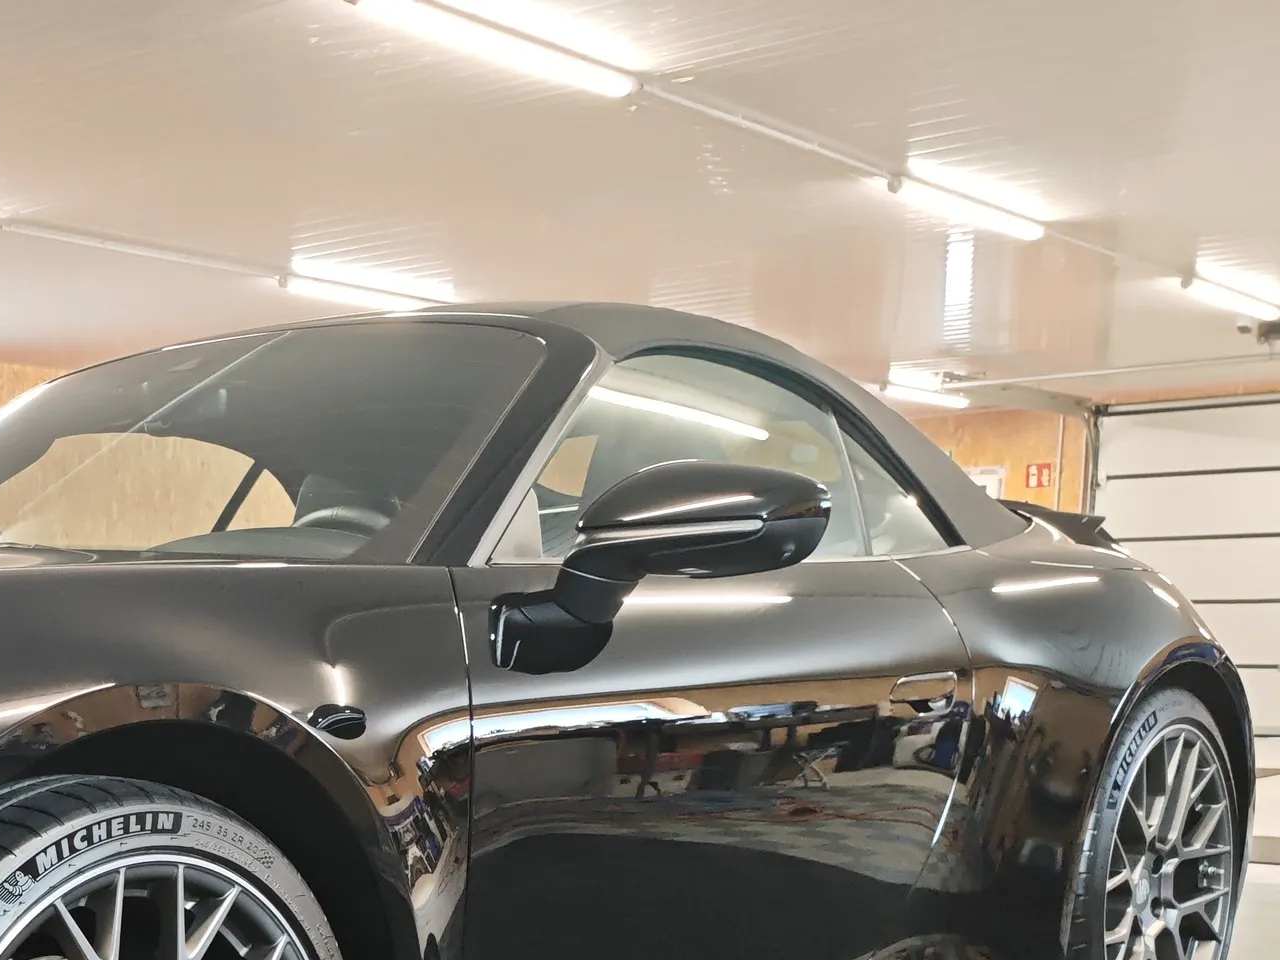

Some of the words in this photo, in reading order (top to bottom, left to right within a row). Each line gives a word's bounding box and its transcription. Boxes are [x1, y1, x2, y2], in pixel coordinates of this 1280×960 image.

[1115, 712, 1158, 786] MICHELIN
[35, 813, 175, 874] MICHELIN
[231, 832, 245, 846] ZR
